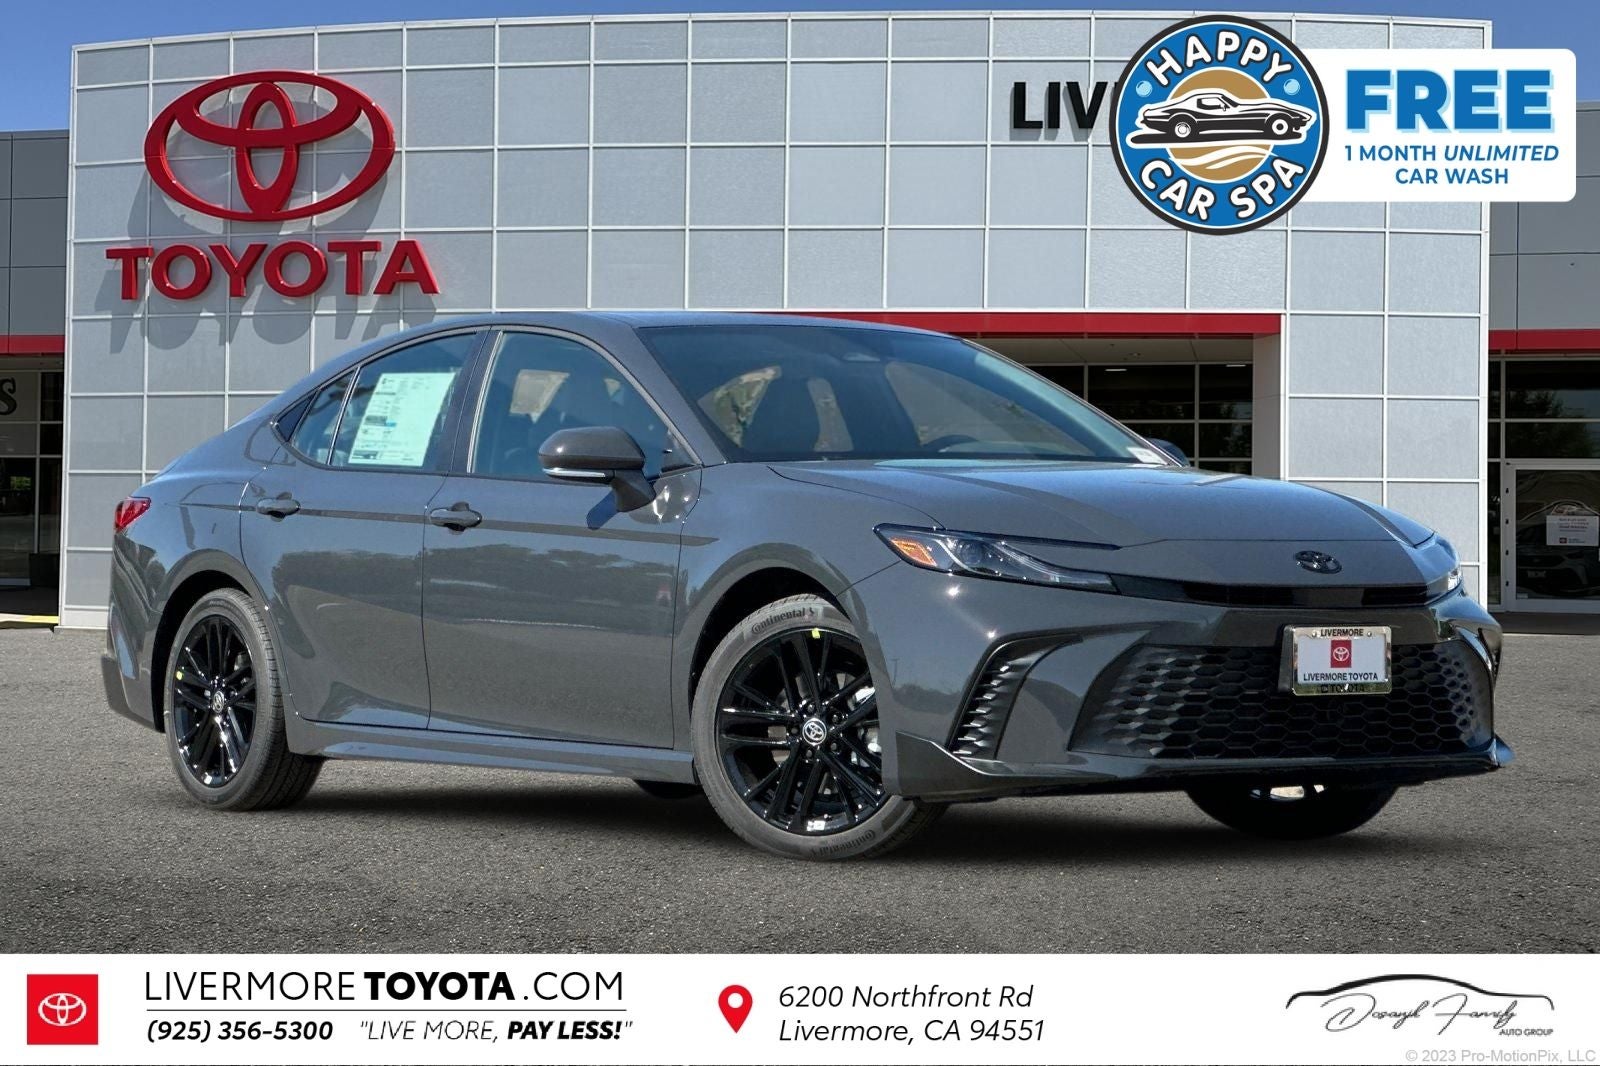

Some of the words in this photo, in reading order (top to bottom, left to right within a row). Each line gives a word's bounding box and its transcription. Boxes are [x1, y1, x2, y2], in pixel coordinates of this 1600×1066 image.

[1013, 82, 1119, 129] LIV
[105, 239, 441, 300] TOYOTA
[751, 606, 806, 634] Continental
[1320, 628, 1364, 637] LIVERMORE
[1303, 672, 1347, 681] LIVERMORE
[1348, 672, 1378, 681] TOYOTA
